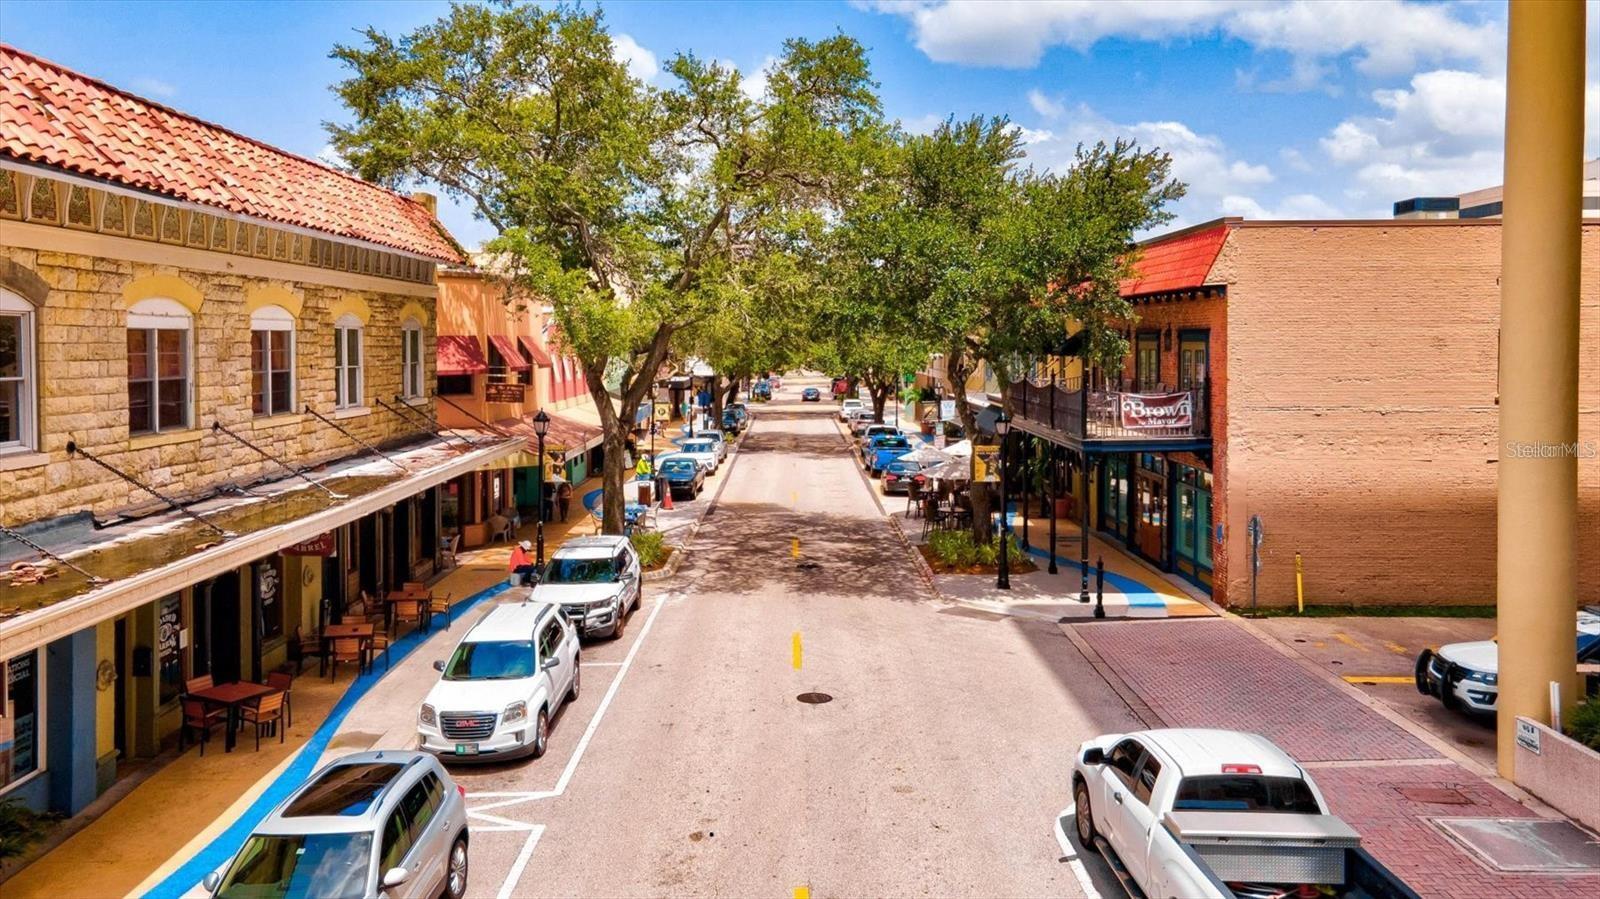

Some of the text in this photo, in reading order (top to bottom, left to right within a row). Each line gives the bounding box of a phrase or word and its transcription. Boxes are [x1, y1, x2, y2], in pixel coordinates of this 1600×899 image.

[1122, 400, 1190, 417] Brown
[1148, 417, 1176, 426] Mayor
[456, 719, 480, 728] GMC
